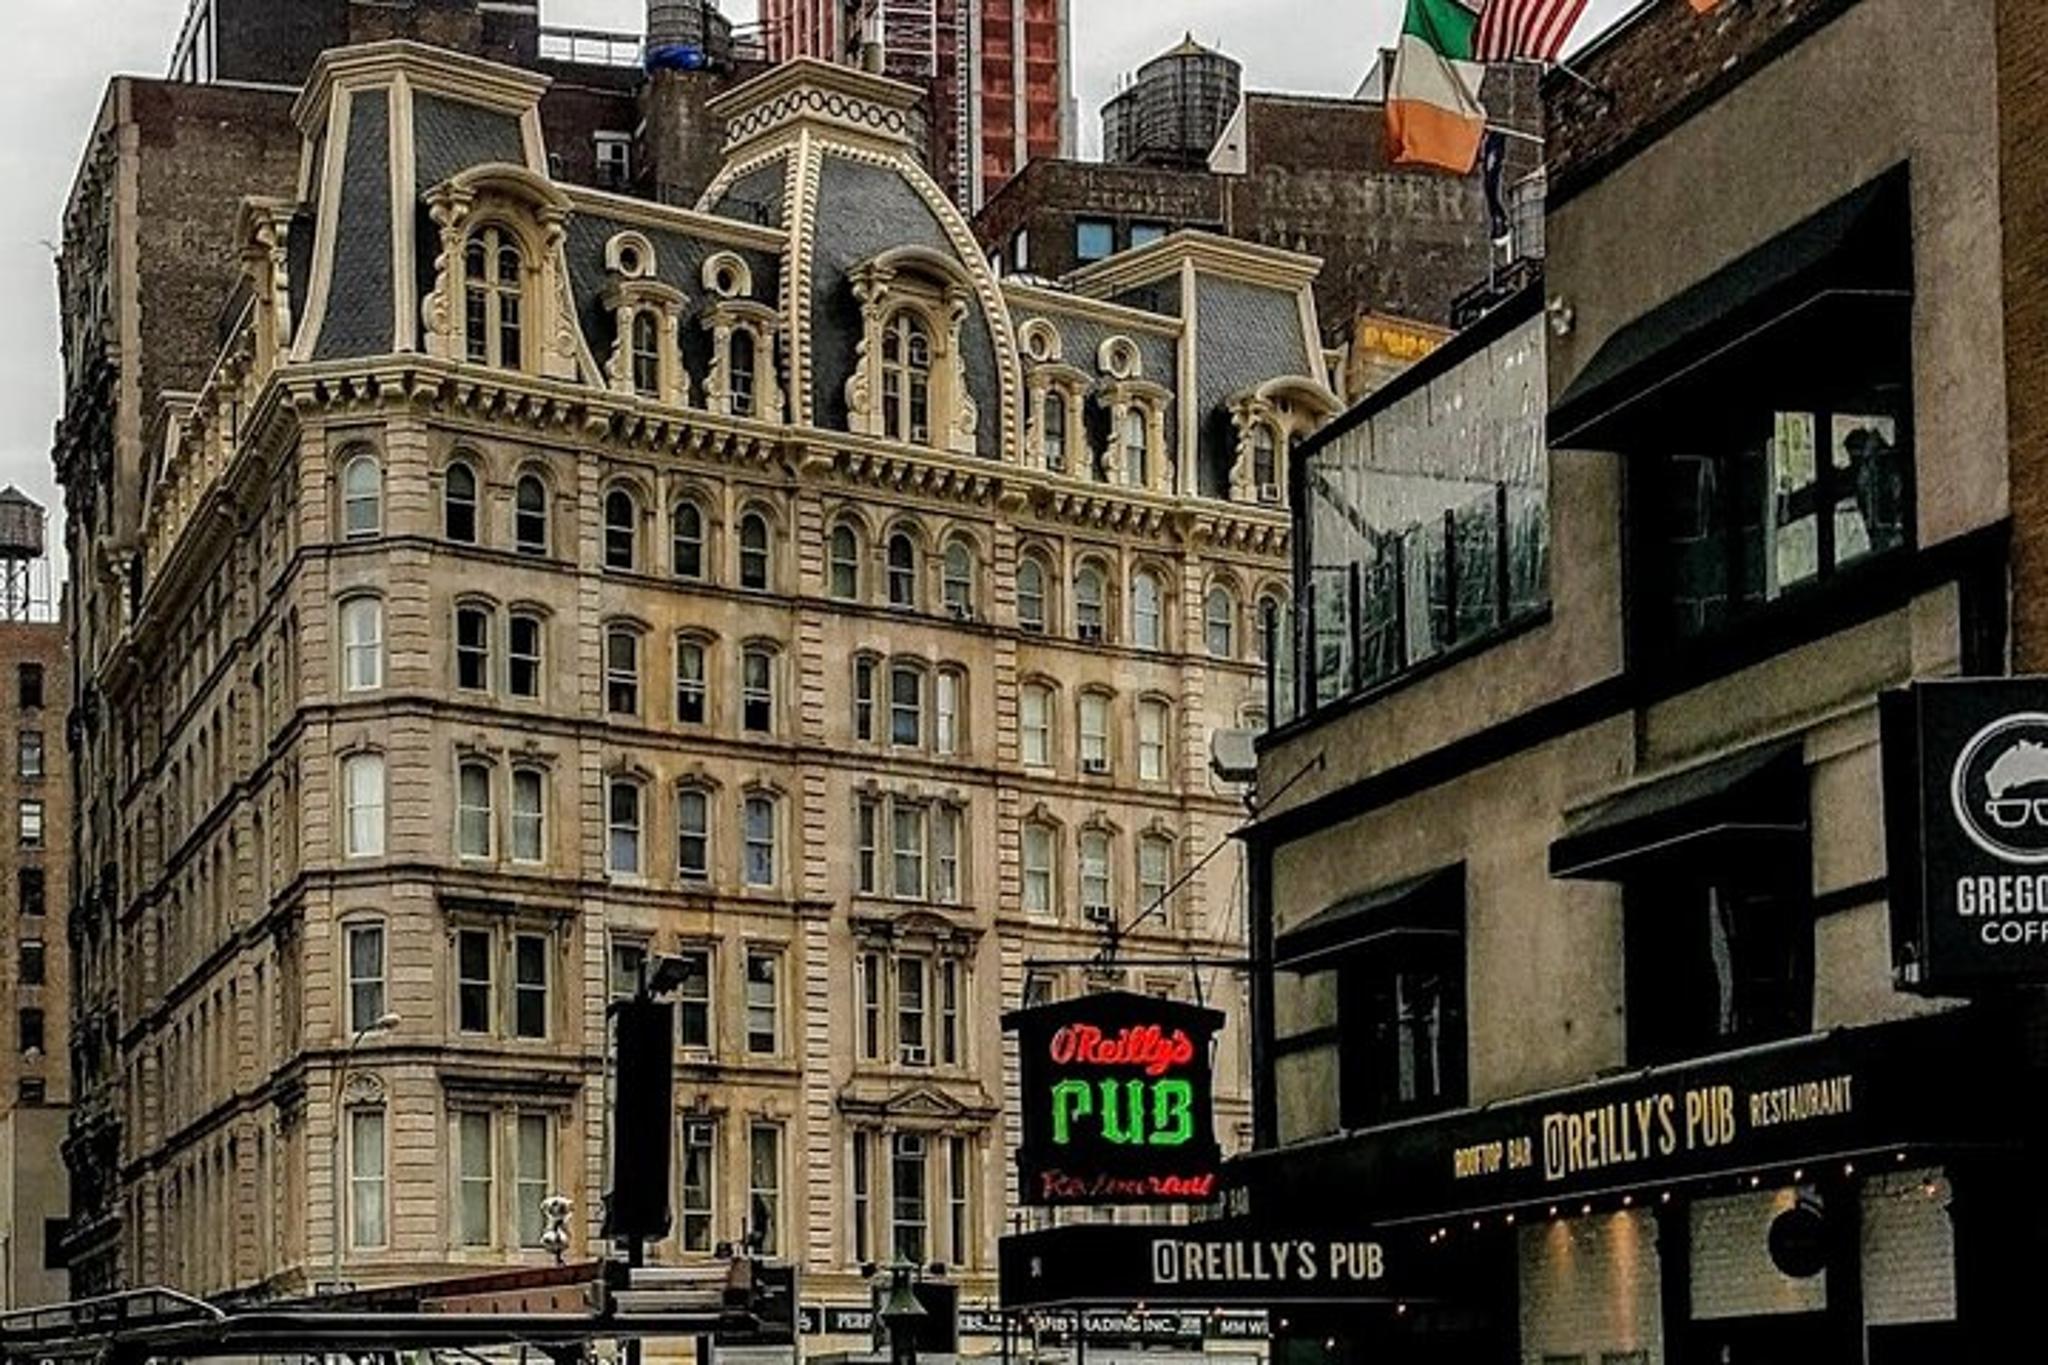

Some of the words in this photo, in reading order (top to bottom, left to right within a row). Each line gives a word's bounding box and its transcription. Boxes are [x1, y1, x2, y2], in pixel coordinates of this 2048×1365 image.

[1050, 1023, 1193, 1075] O'Reilly's
[1051, 1078, 1193, 1145] PUB
[1507, 1136, 1531, 1169] BAR
[1544, 1094, 1676, 1180] O'REILLY'S
[1686, 1085, 1736, 1150] PUB
[1748, 1075, 1853, 1127] RESTAURANT
[1153, 1239, 1318, 1284] O'REILLY'S
[1330, 1242, 1384, 1280] PUB
